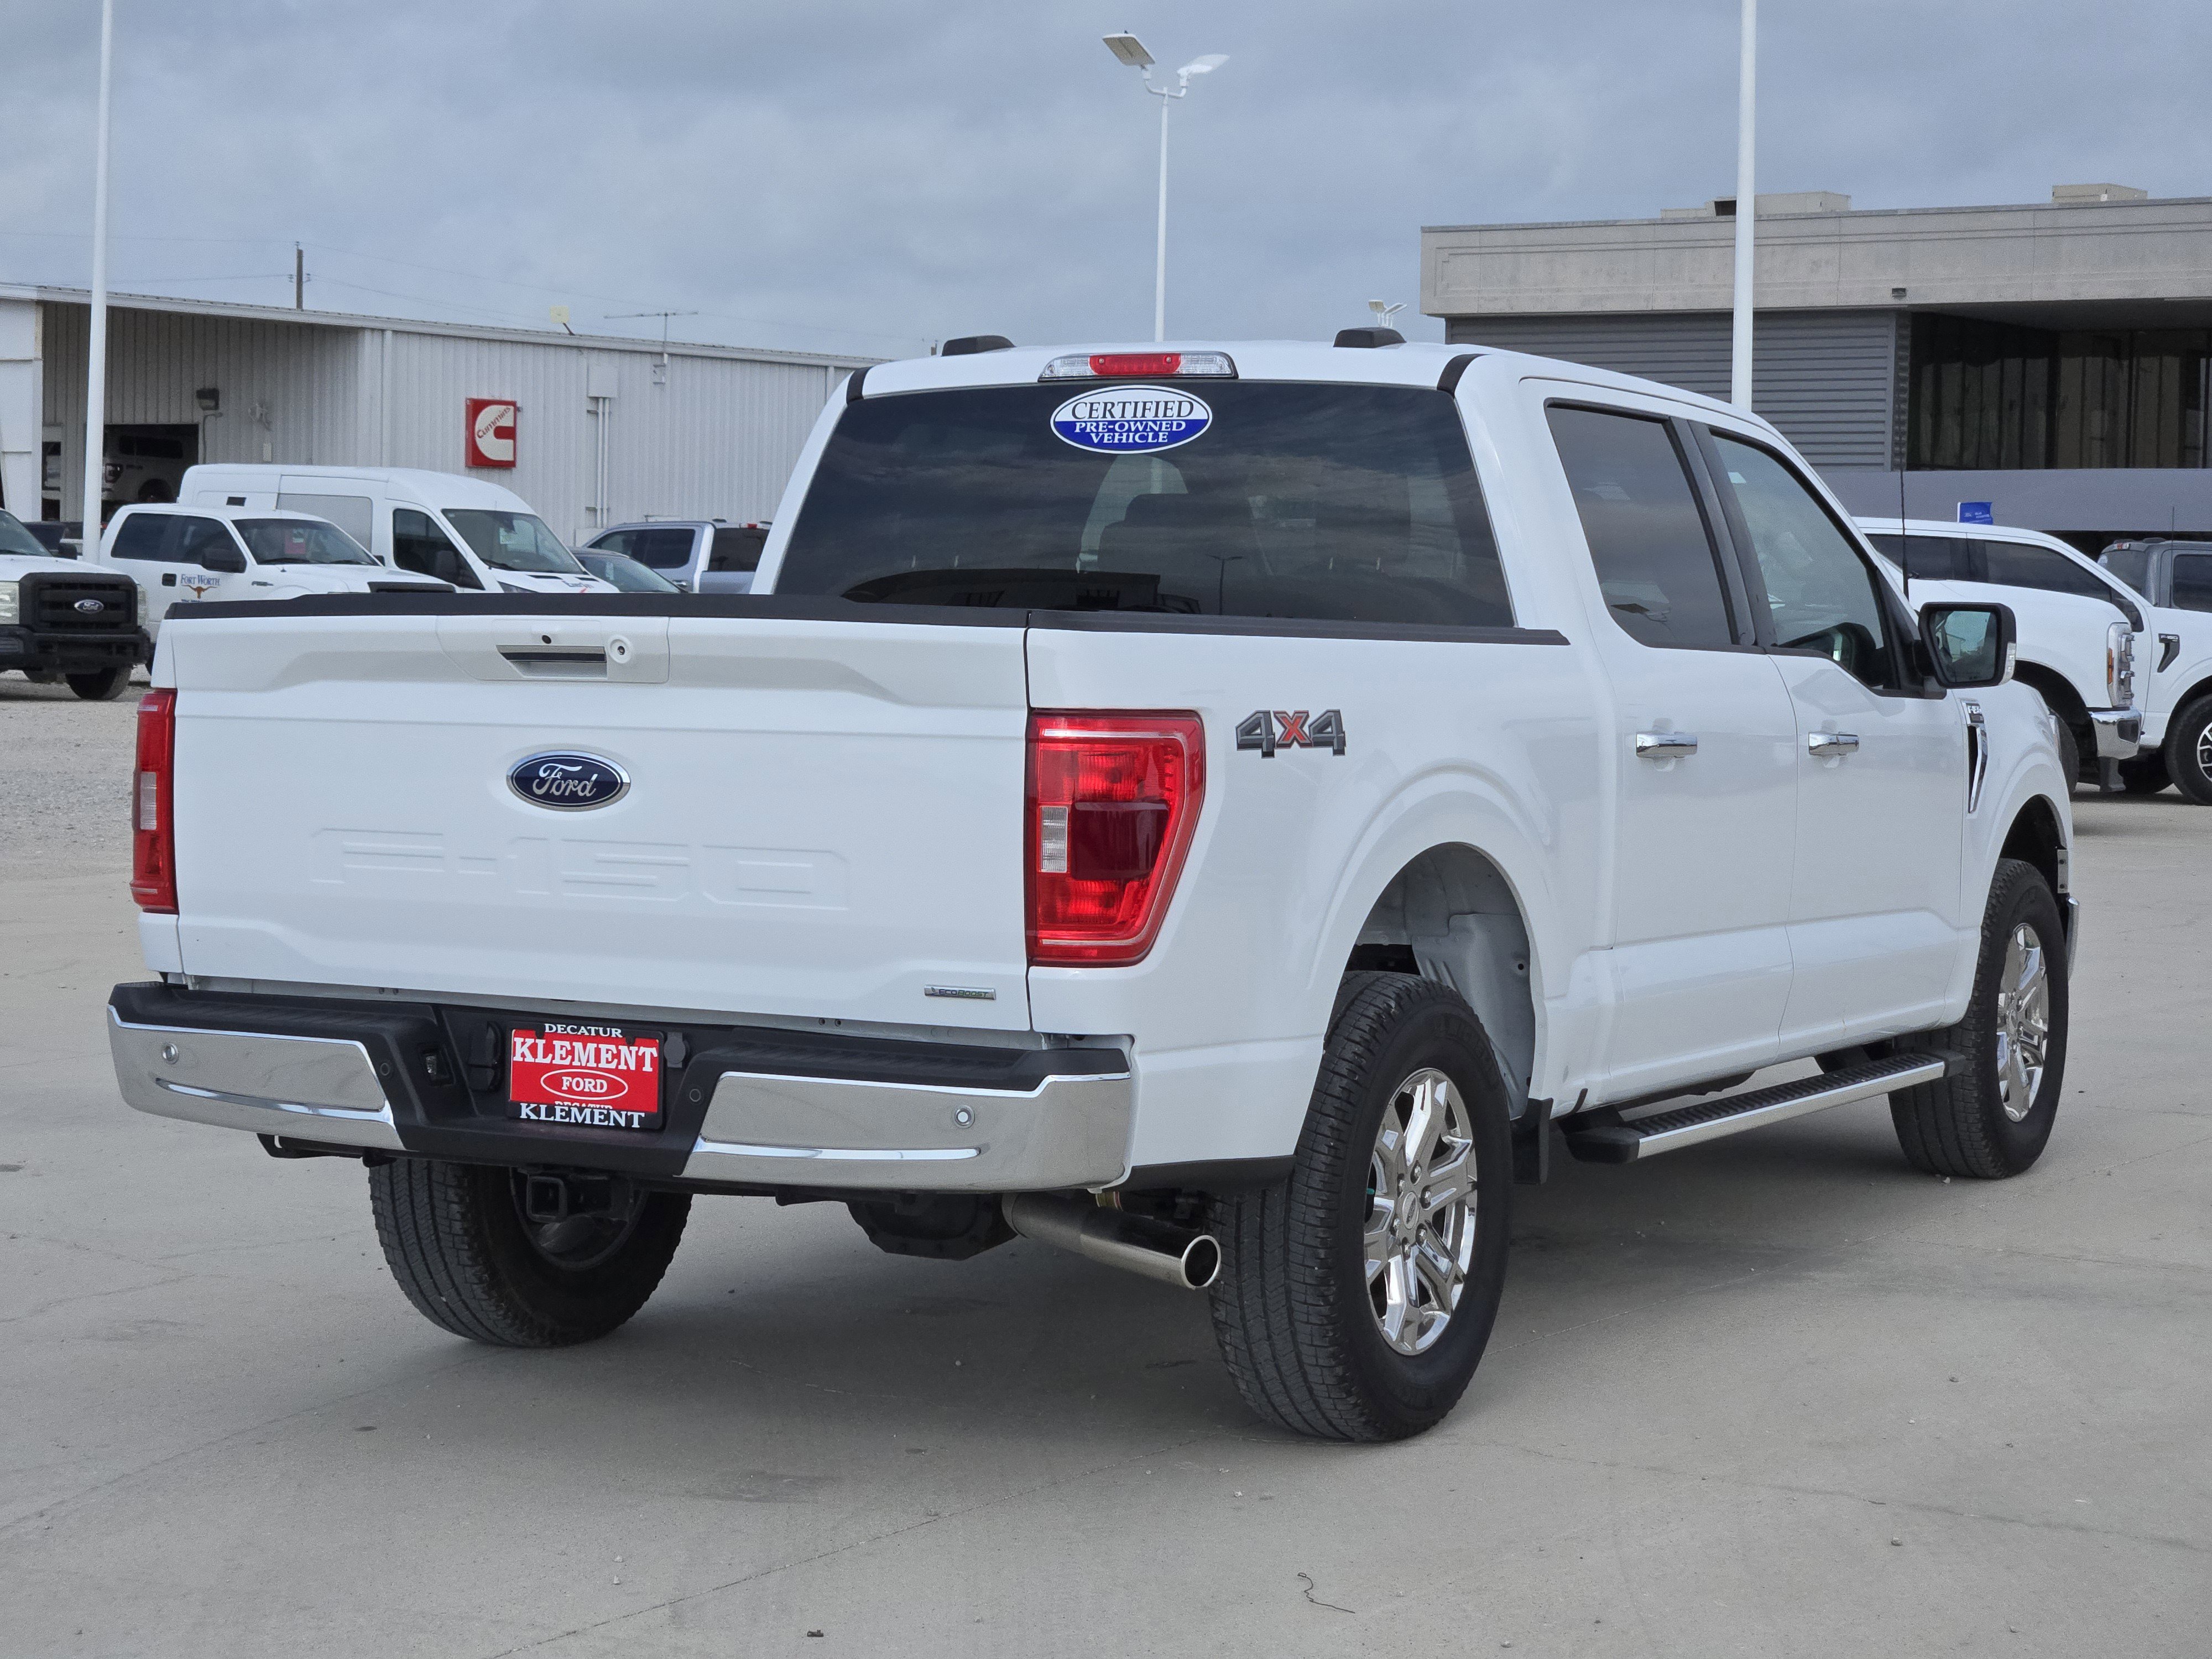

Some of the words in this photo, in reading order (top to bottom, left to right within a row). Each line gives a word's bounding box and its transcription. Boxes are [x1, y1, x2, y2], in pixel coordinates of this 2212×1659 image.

[1071, 400, 1194, 420] CERTIFIED
[477, 407, 510, 439] Cummins
[1074, 420, 1186, 433] PRE-OWNED
[1090, 432, 1168, 444] VEHICLE
[533, 763, 598, 797] Ford
[544, 1023, 623, 1038] DECATUR
[513, 1037, 658, 1072] KLEMENT
[561, 1076, 608, 1093] FORD
[520, 1103, 645, 1128] KLEMENT
